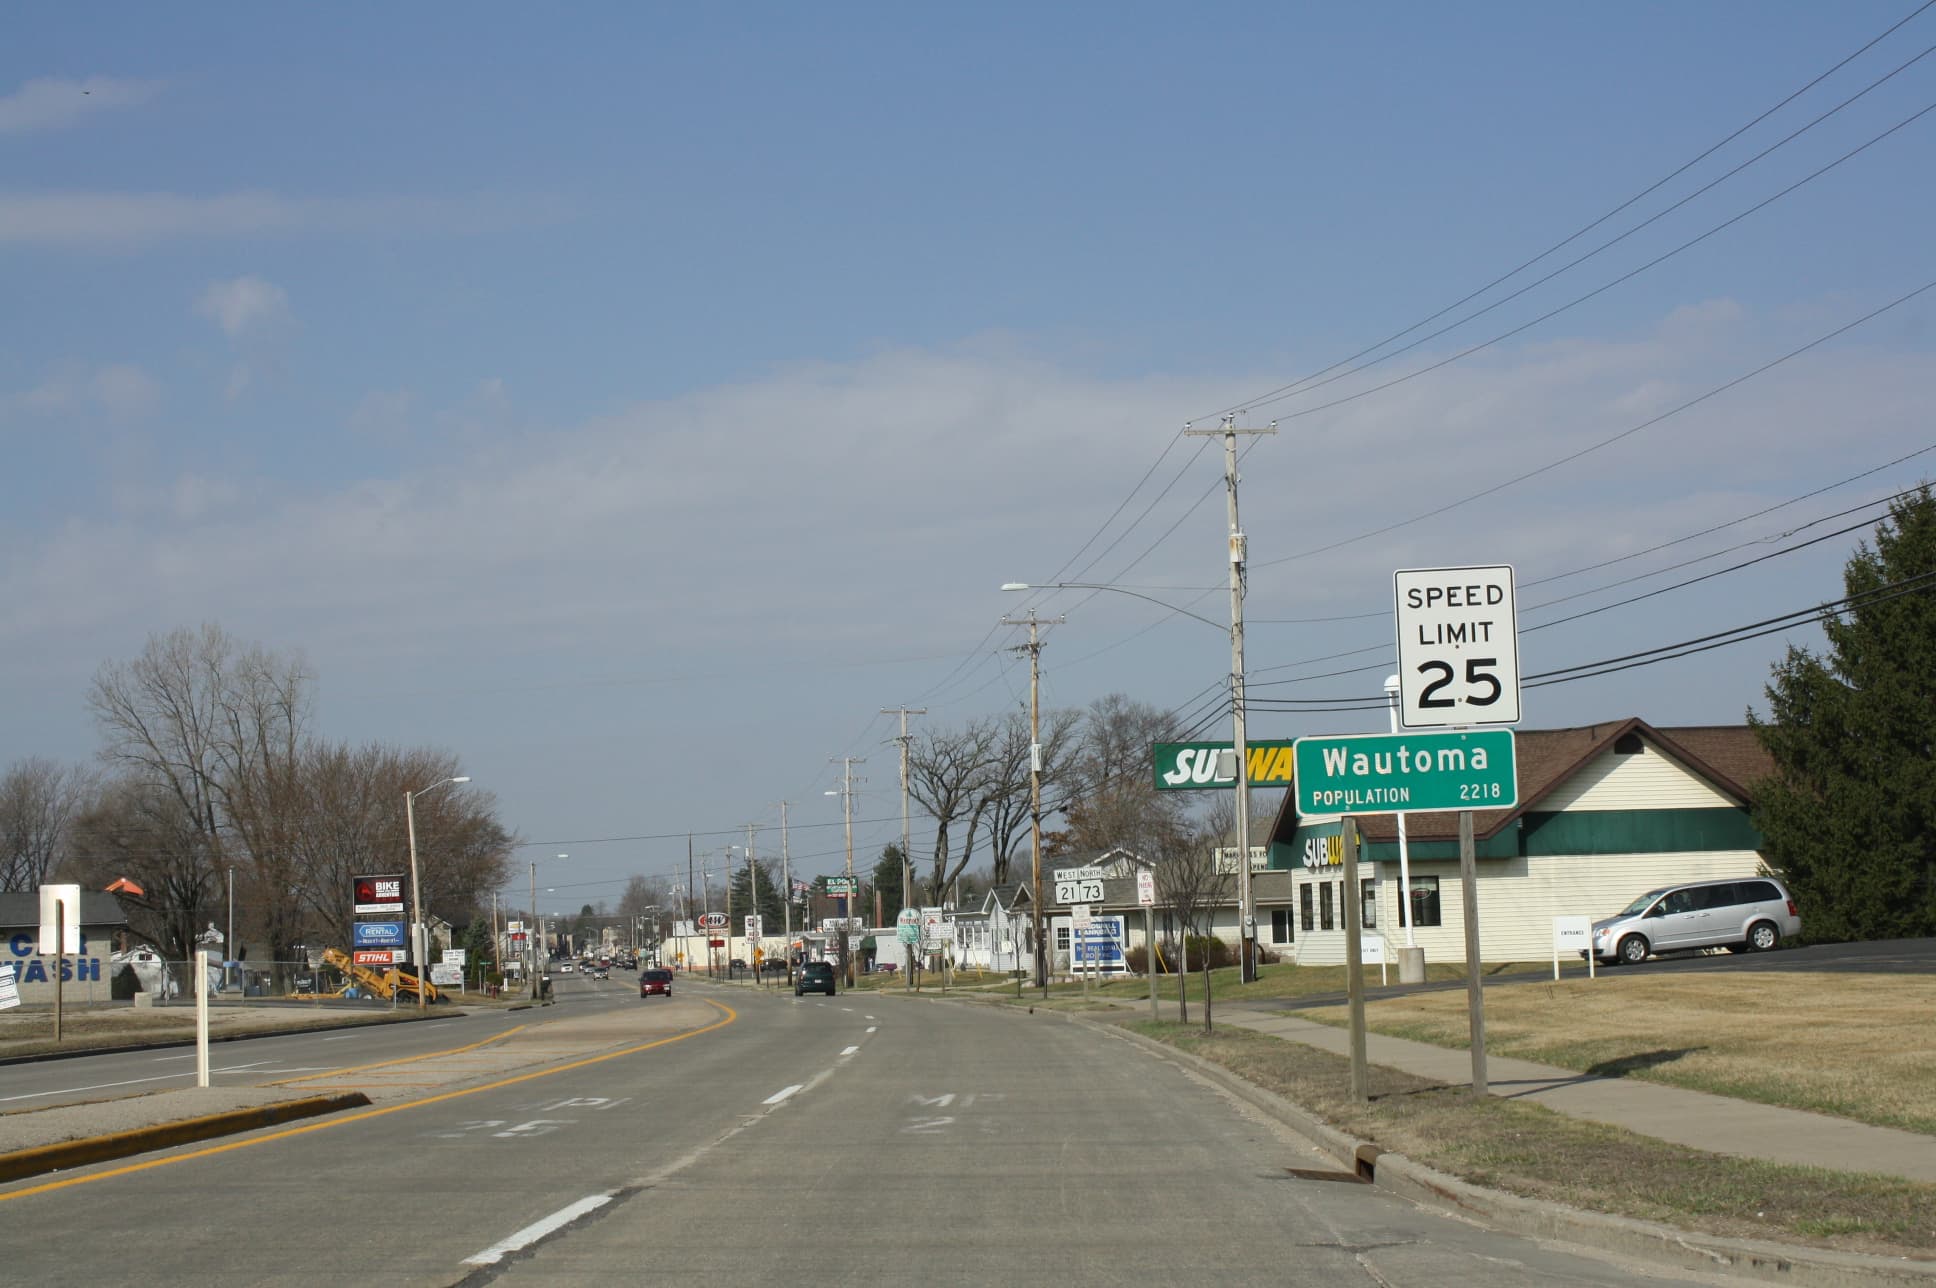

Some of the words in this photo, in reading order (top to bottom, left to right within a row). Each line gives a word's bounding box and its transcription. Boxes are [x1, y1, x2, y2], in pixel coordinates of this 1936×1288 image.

[1407, 584, 1504, 609] SPEED
[1418, 621, 1494, 645] LIMIT
[1417, 658, 1502, 709] 25
[1163, 747, 1293, 786] SUWA
[1322, 745, 1488, 777] Wautoma
[1313, 787, 1410, 806] POPULATION
[1460, 783, 1500, 800] 2218
[1303, 834, 1361, 868] SUBW
[1081, 870, 1101, 878] NORTH
[376, 882, 400, 891] BIKE
[1062, 887, 1075, 900] 21
[1083, 885, 1101, 899] 73
[358, 953, 389, 962] STIHL
